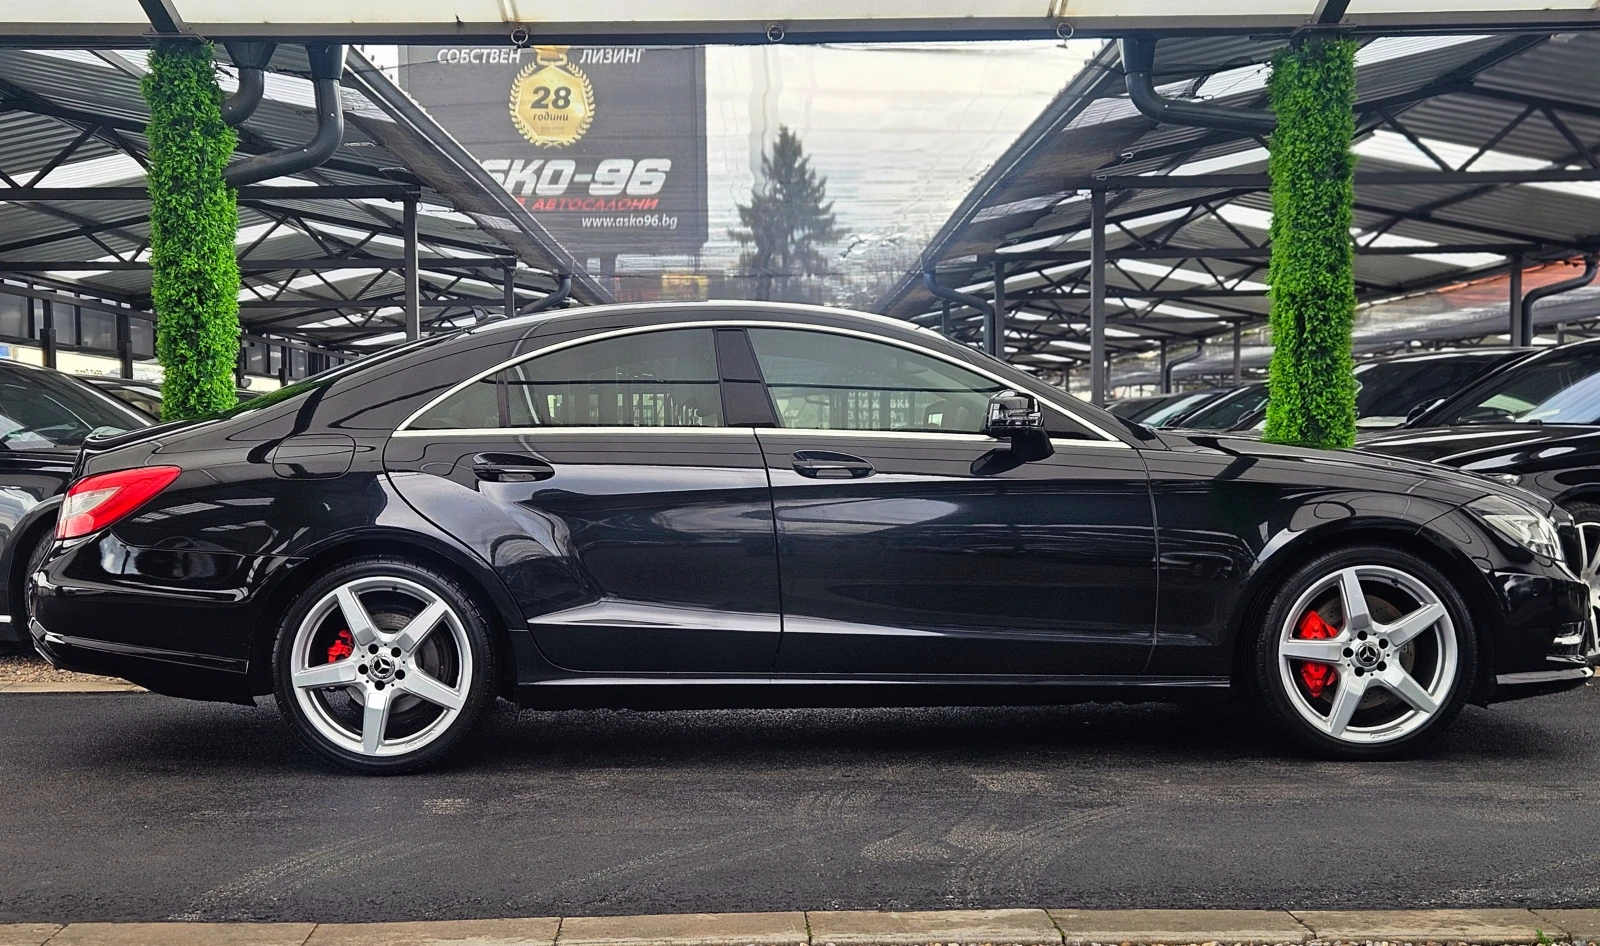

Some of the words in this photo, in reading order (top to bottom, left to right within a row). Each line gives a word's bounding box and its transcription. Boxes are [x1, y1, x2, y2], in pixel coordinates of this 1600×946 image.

[437, 48, 521, 64] СОБСТВЕН
[579, 48, 645, 64] ЛИЗИНГ
[530, 86, 571, 109] 28
[533, 111, 569, 121] години
[477, 158, 672, 196] SKO-96
[531, 197, 659, 211] АВТОСАЛОНИ
[582, 213, 678, 229] www.asko96.bg
